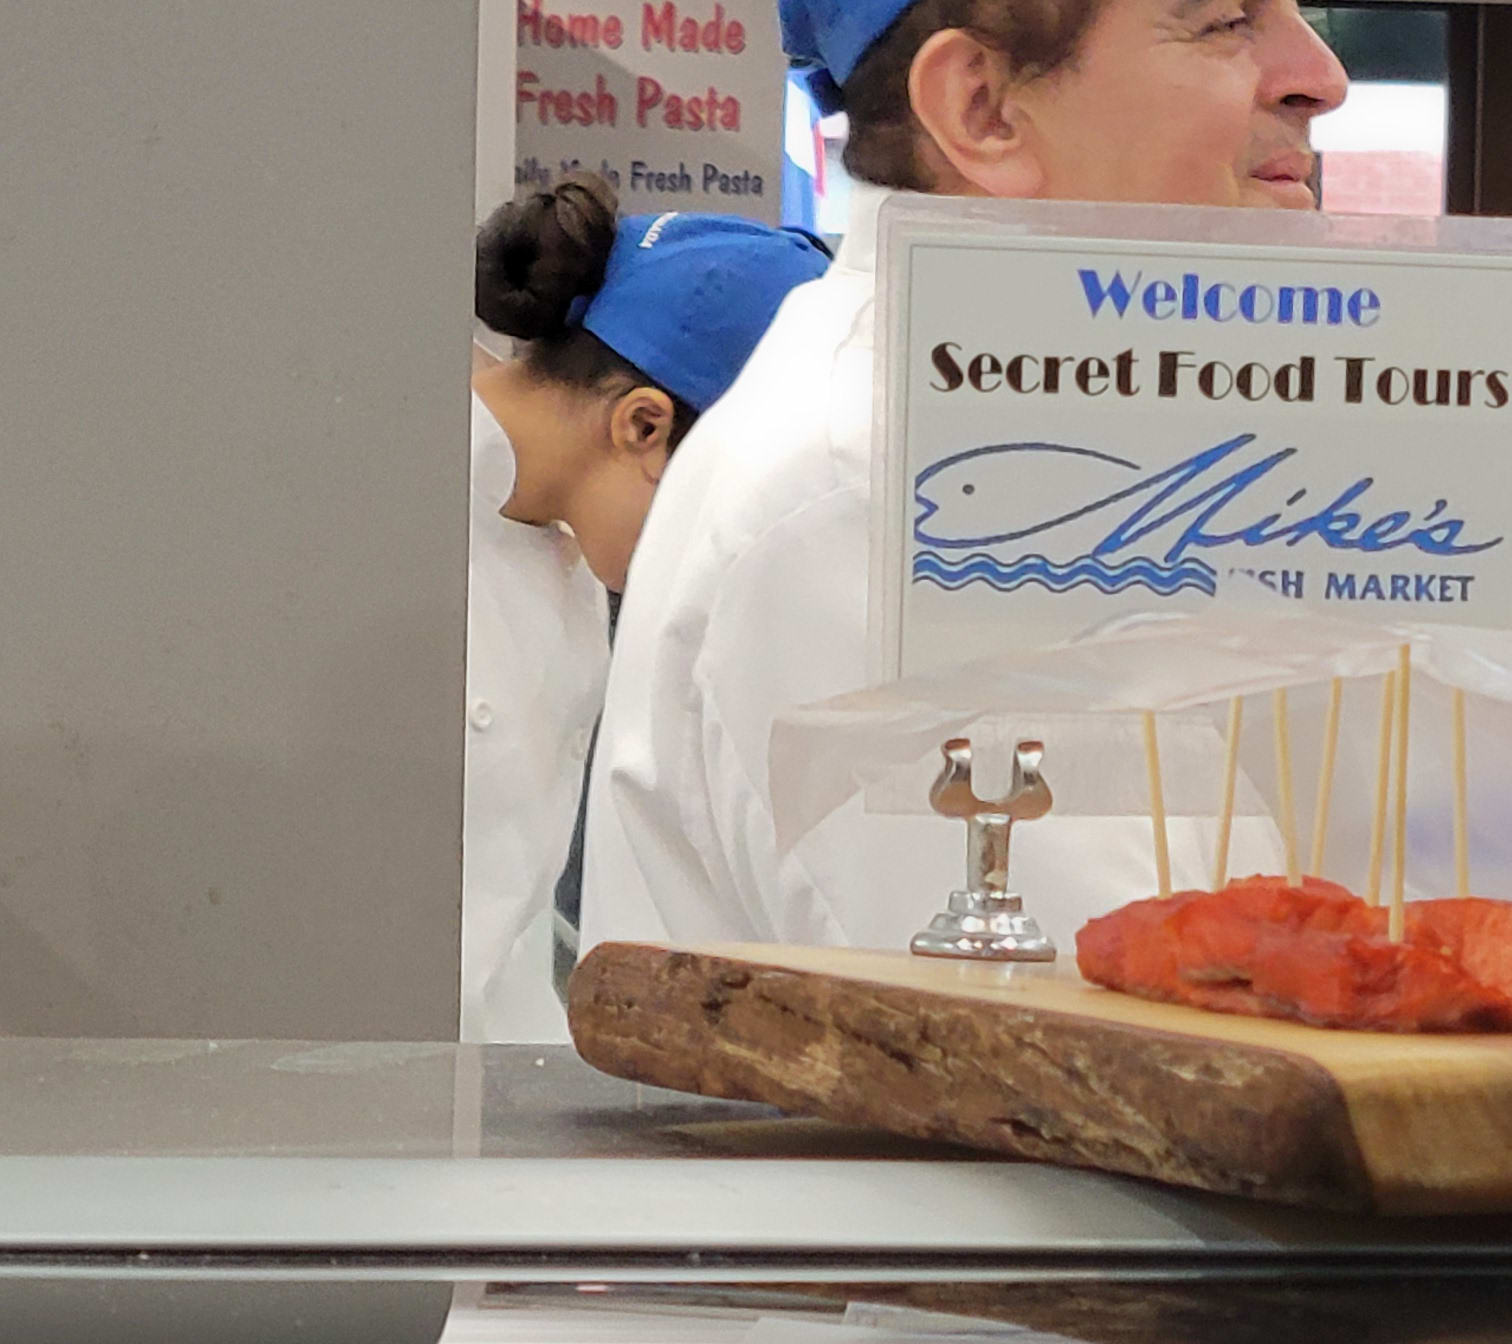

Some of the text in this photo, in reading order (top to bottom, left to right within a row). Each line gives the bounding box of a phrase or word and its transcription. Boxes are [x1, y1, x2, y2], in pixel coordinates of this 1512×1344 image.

[641, 1, 747, 55] Made
[515, 70, 742, 132] Fresh Pasta
[630, 160, 693, 194] Fresh
[702, 162, 765, 196] Pasta
[1078, 268, 1382, 328] Welcome
[929, 341, 1510, 409] Secret Food Tours
[1090, 433, 1504, 564] Mike's
[1324, 572, 1476, 603] MARKET
